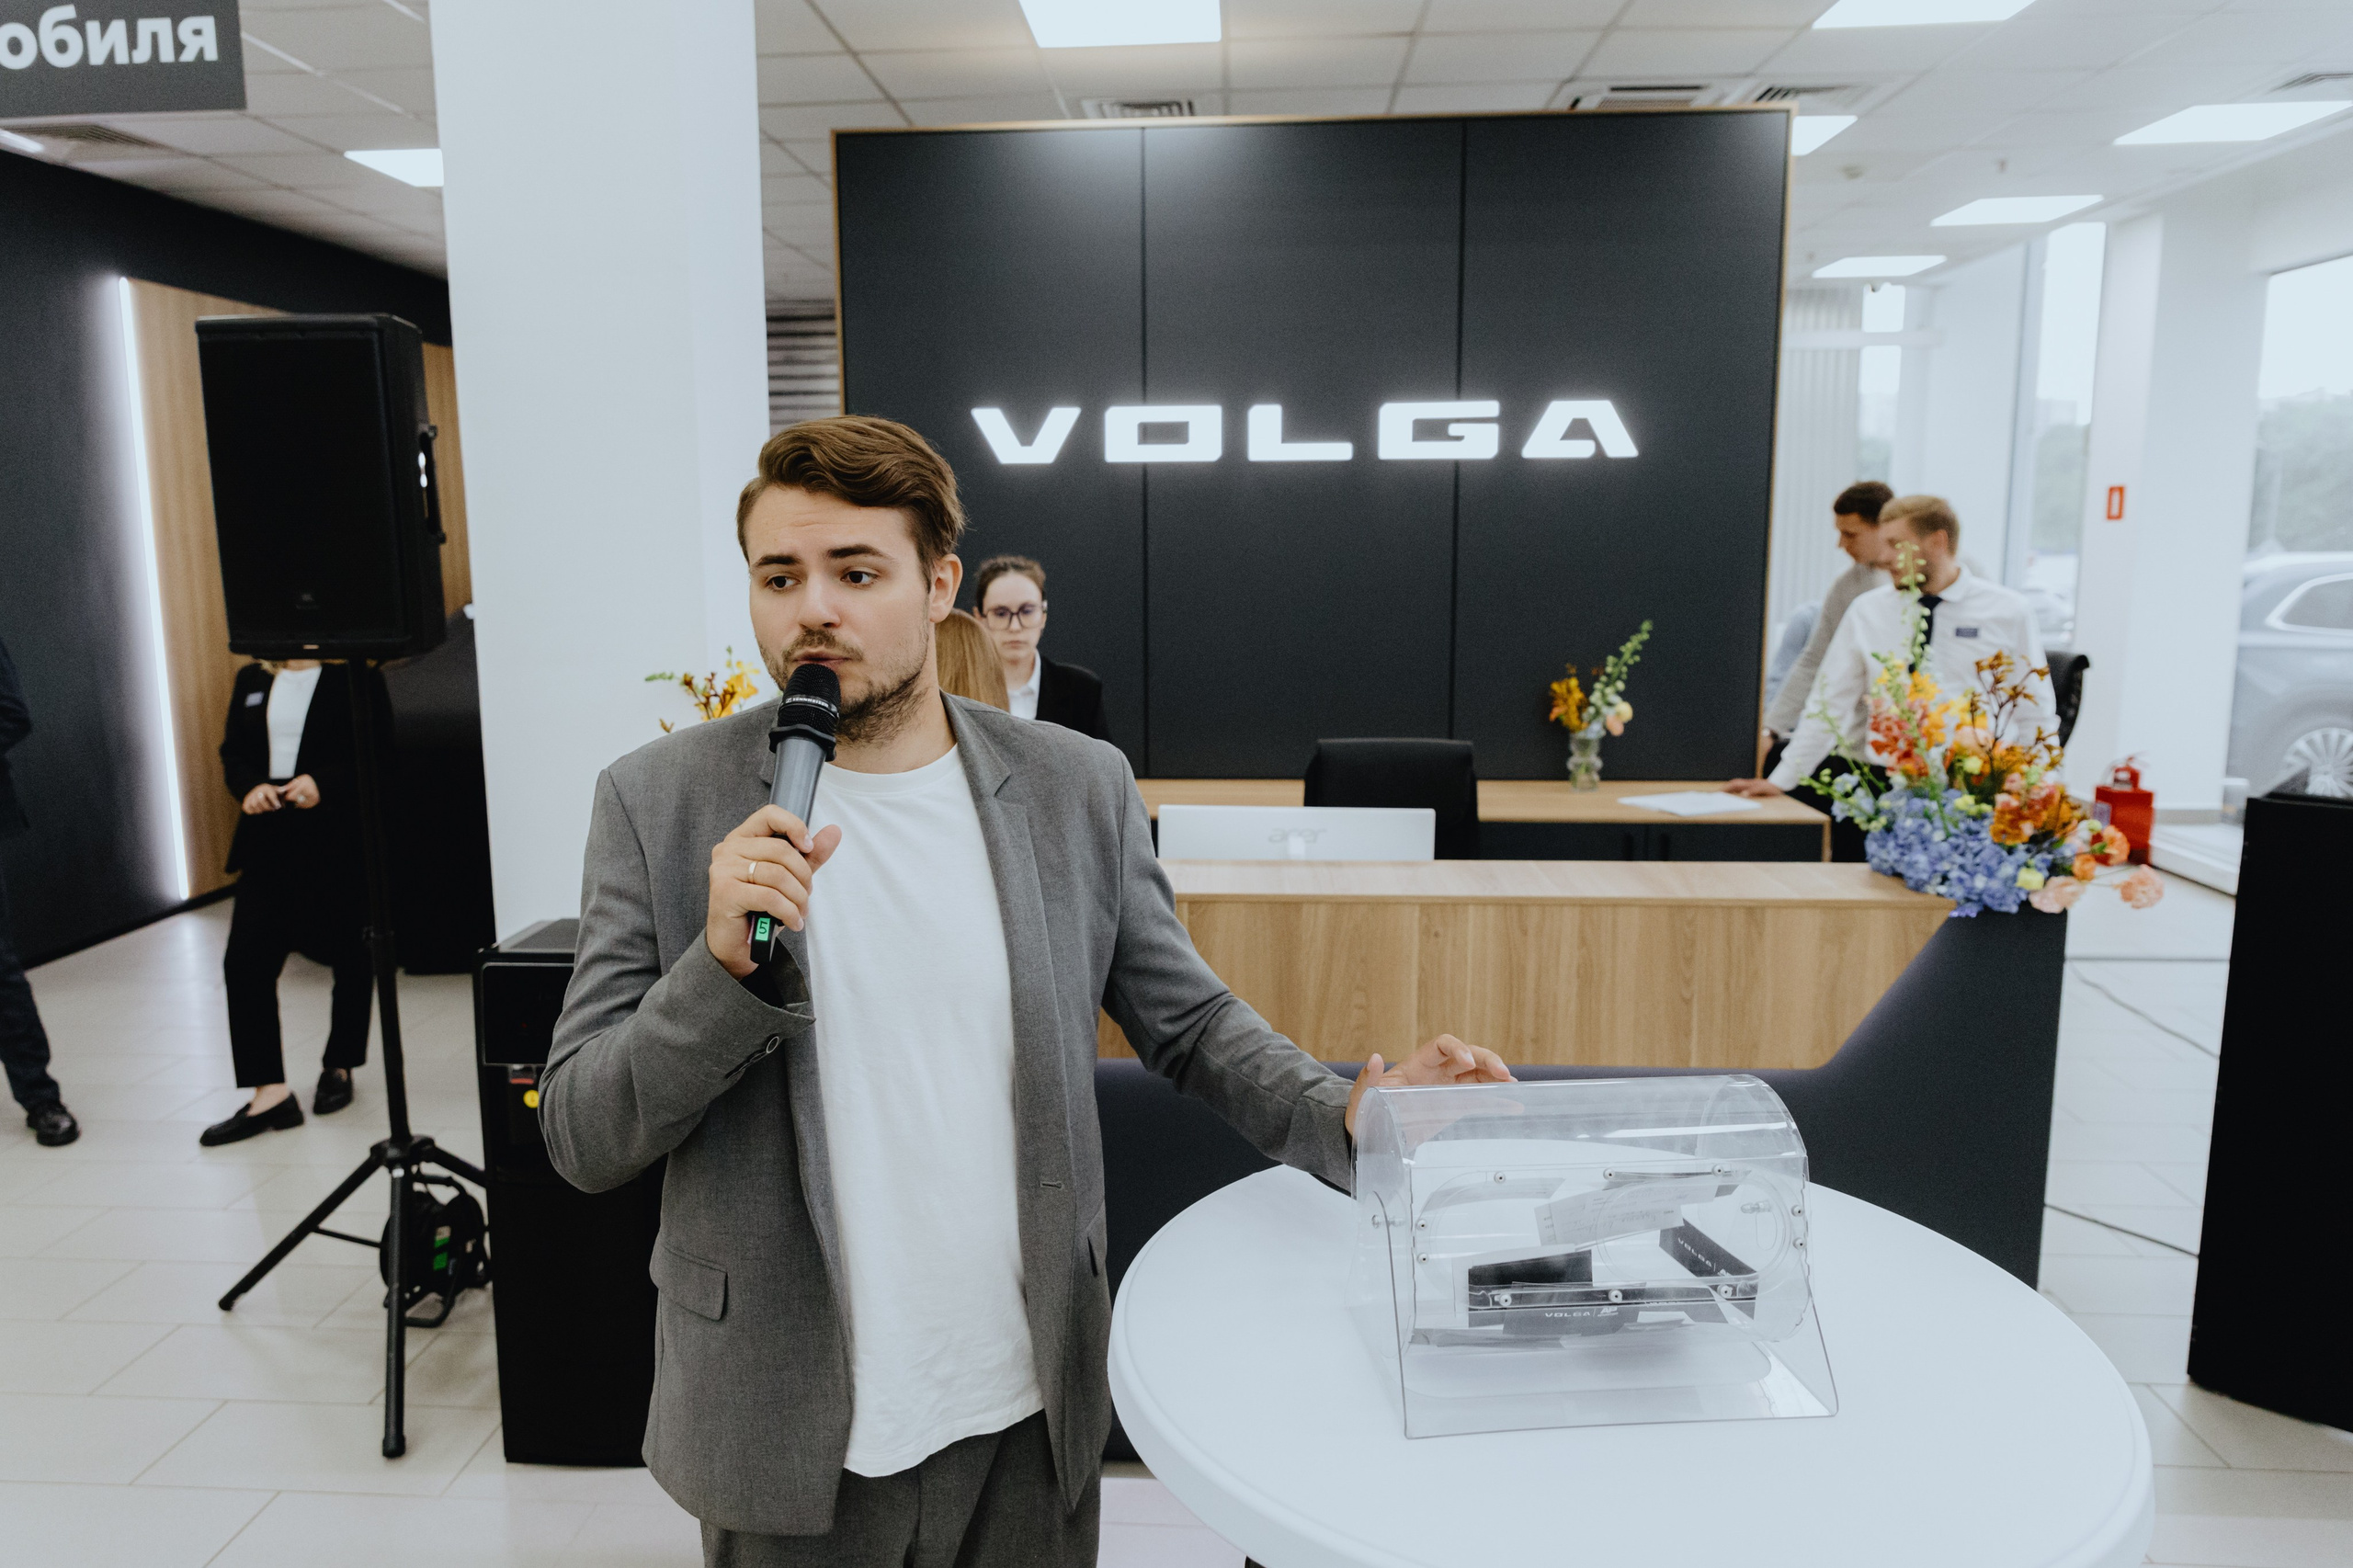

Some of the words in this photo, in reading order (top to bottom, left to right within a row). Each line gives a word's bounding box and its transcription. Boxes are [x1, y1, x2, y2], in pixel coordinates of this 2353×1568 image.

[0, 4, 219, 70] обиля
[971, 399, 1639, 464] VOLGA
[758, 920, 768, 935] 5
[1677, 1237, 1712, 1267] VOLGA
